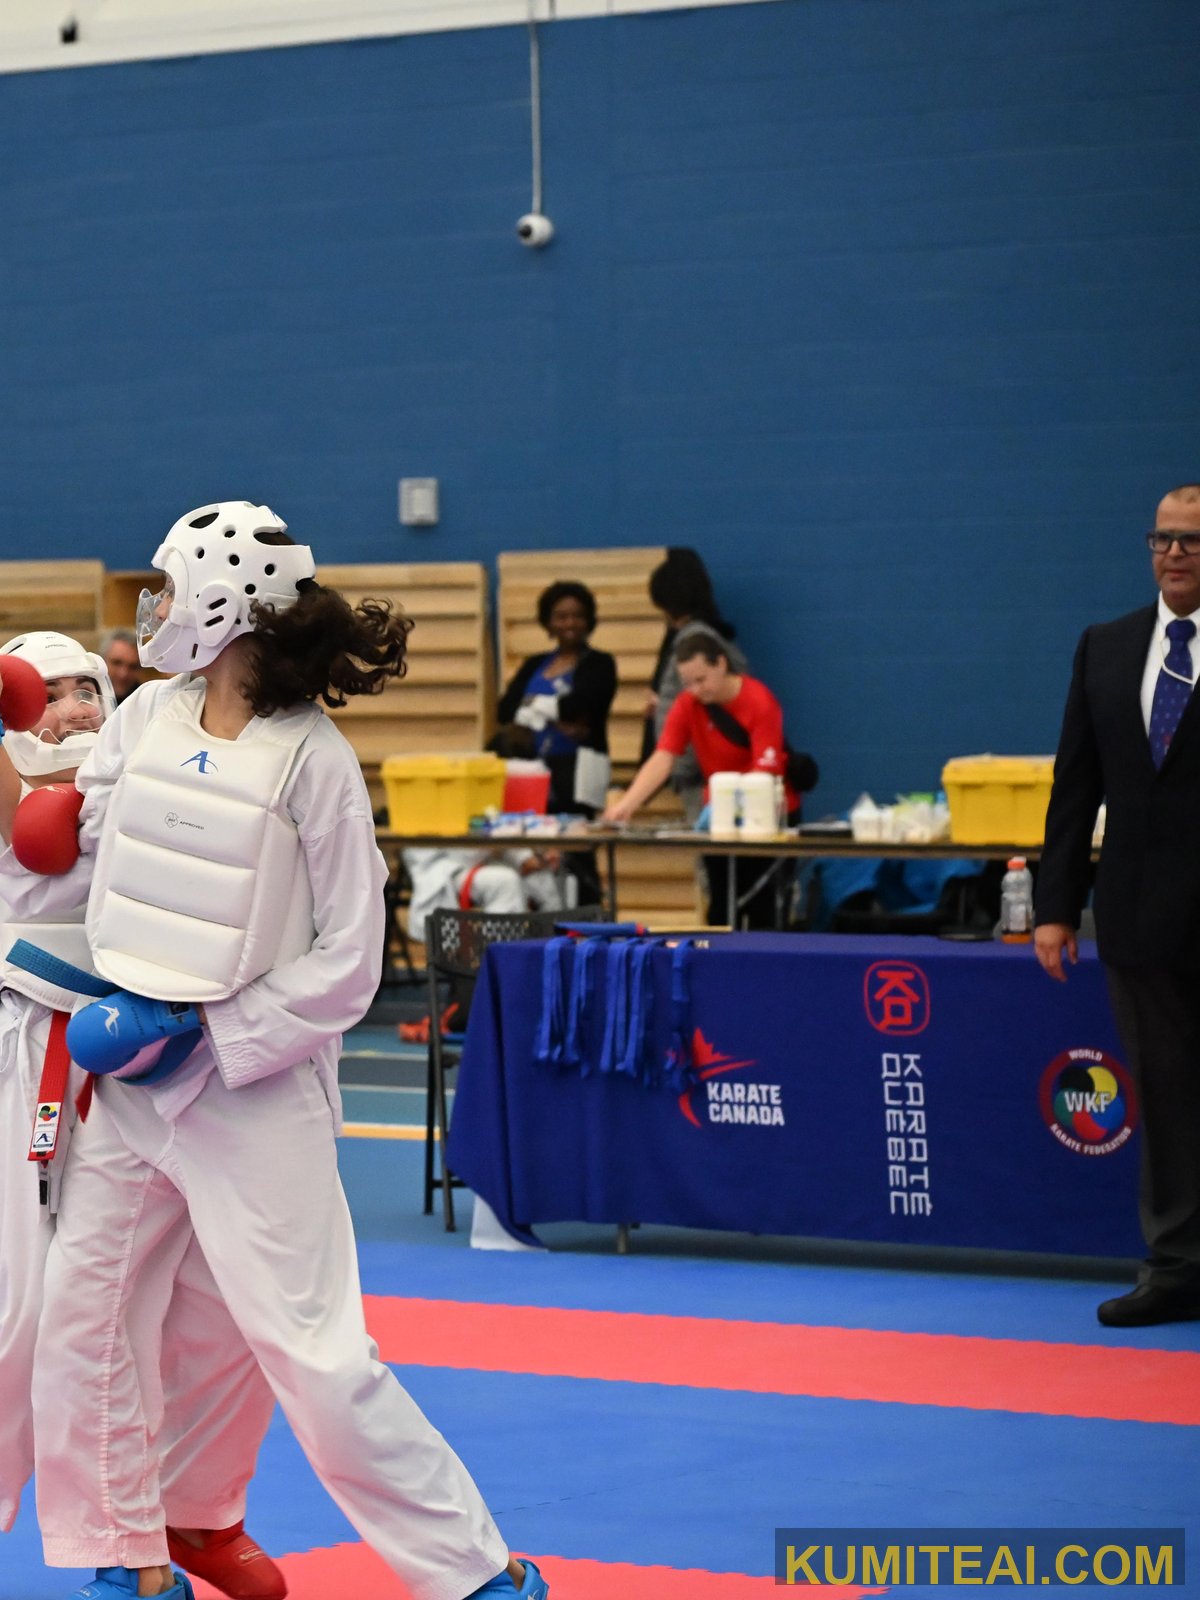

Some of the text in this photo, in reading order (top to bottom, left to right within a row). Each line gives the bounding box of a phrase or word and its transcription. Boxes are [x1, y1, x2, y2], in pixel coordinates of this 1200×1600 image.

[1068, 1048, 1103, 1062] WORLD
[706, 1081, 782, 1105] KARATE
[1064, 1091, 1112, 1114] WKF
[708, 1102, 785, 1126] CANADA
[1049, 1122, 1081, 1153] KARATE
